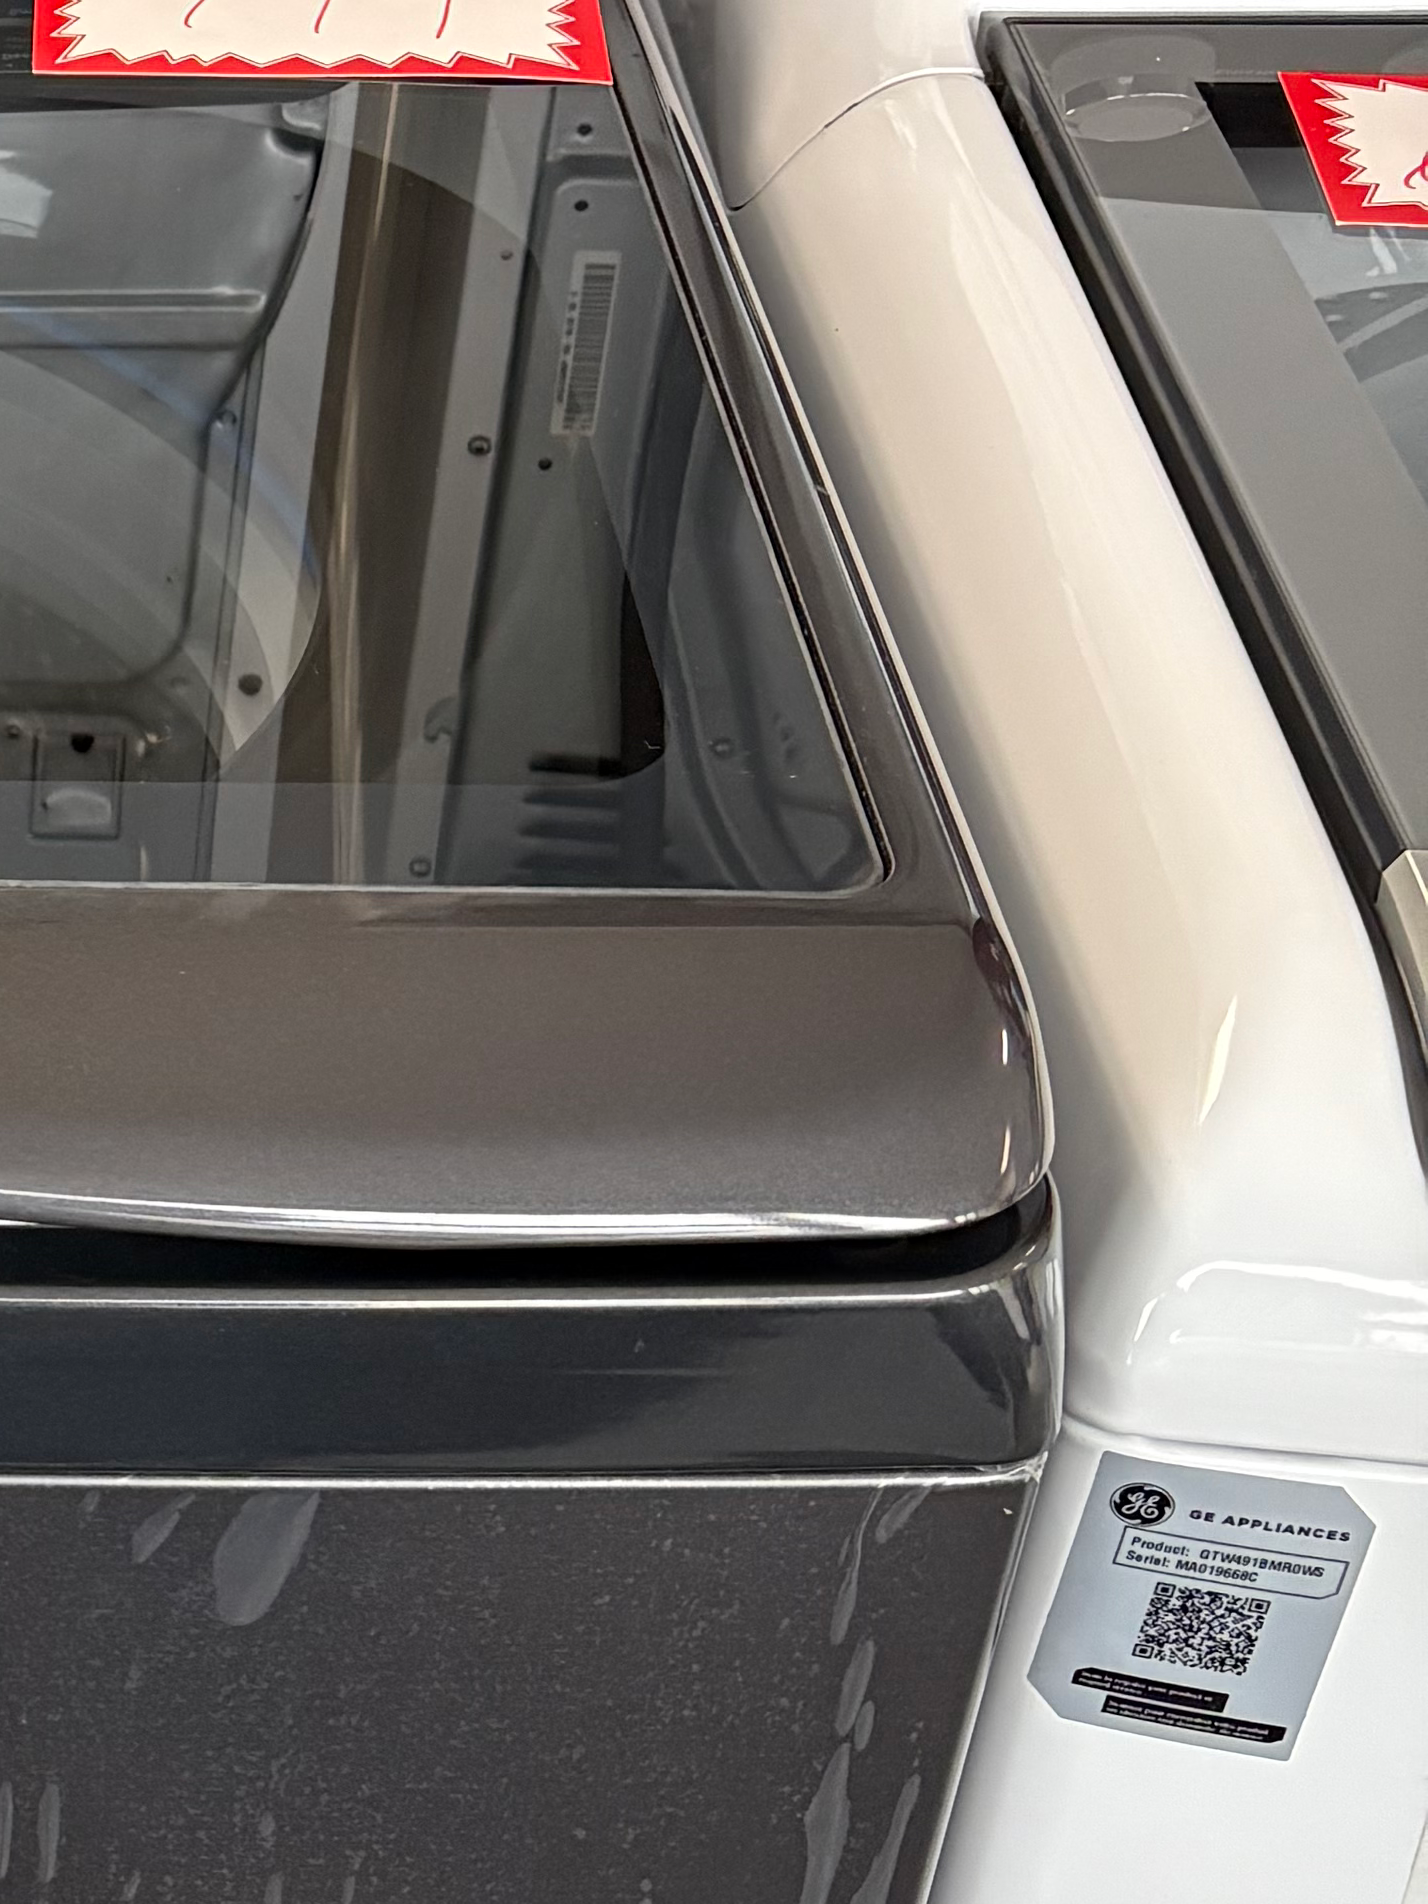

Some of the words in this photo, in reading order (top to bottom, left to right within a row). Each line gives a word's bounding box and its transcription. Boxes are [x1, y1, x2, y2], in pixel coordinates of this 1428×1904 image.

[1188, 1509, 1217, 1524] GE
[1221, 1514, 1352, 1543] APPLIANCES
[1130, 1535, 1190, 1558] Product:
[1125, 1549, 1171, 1569] Serial:
